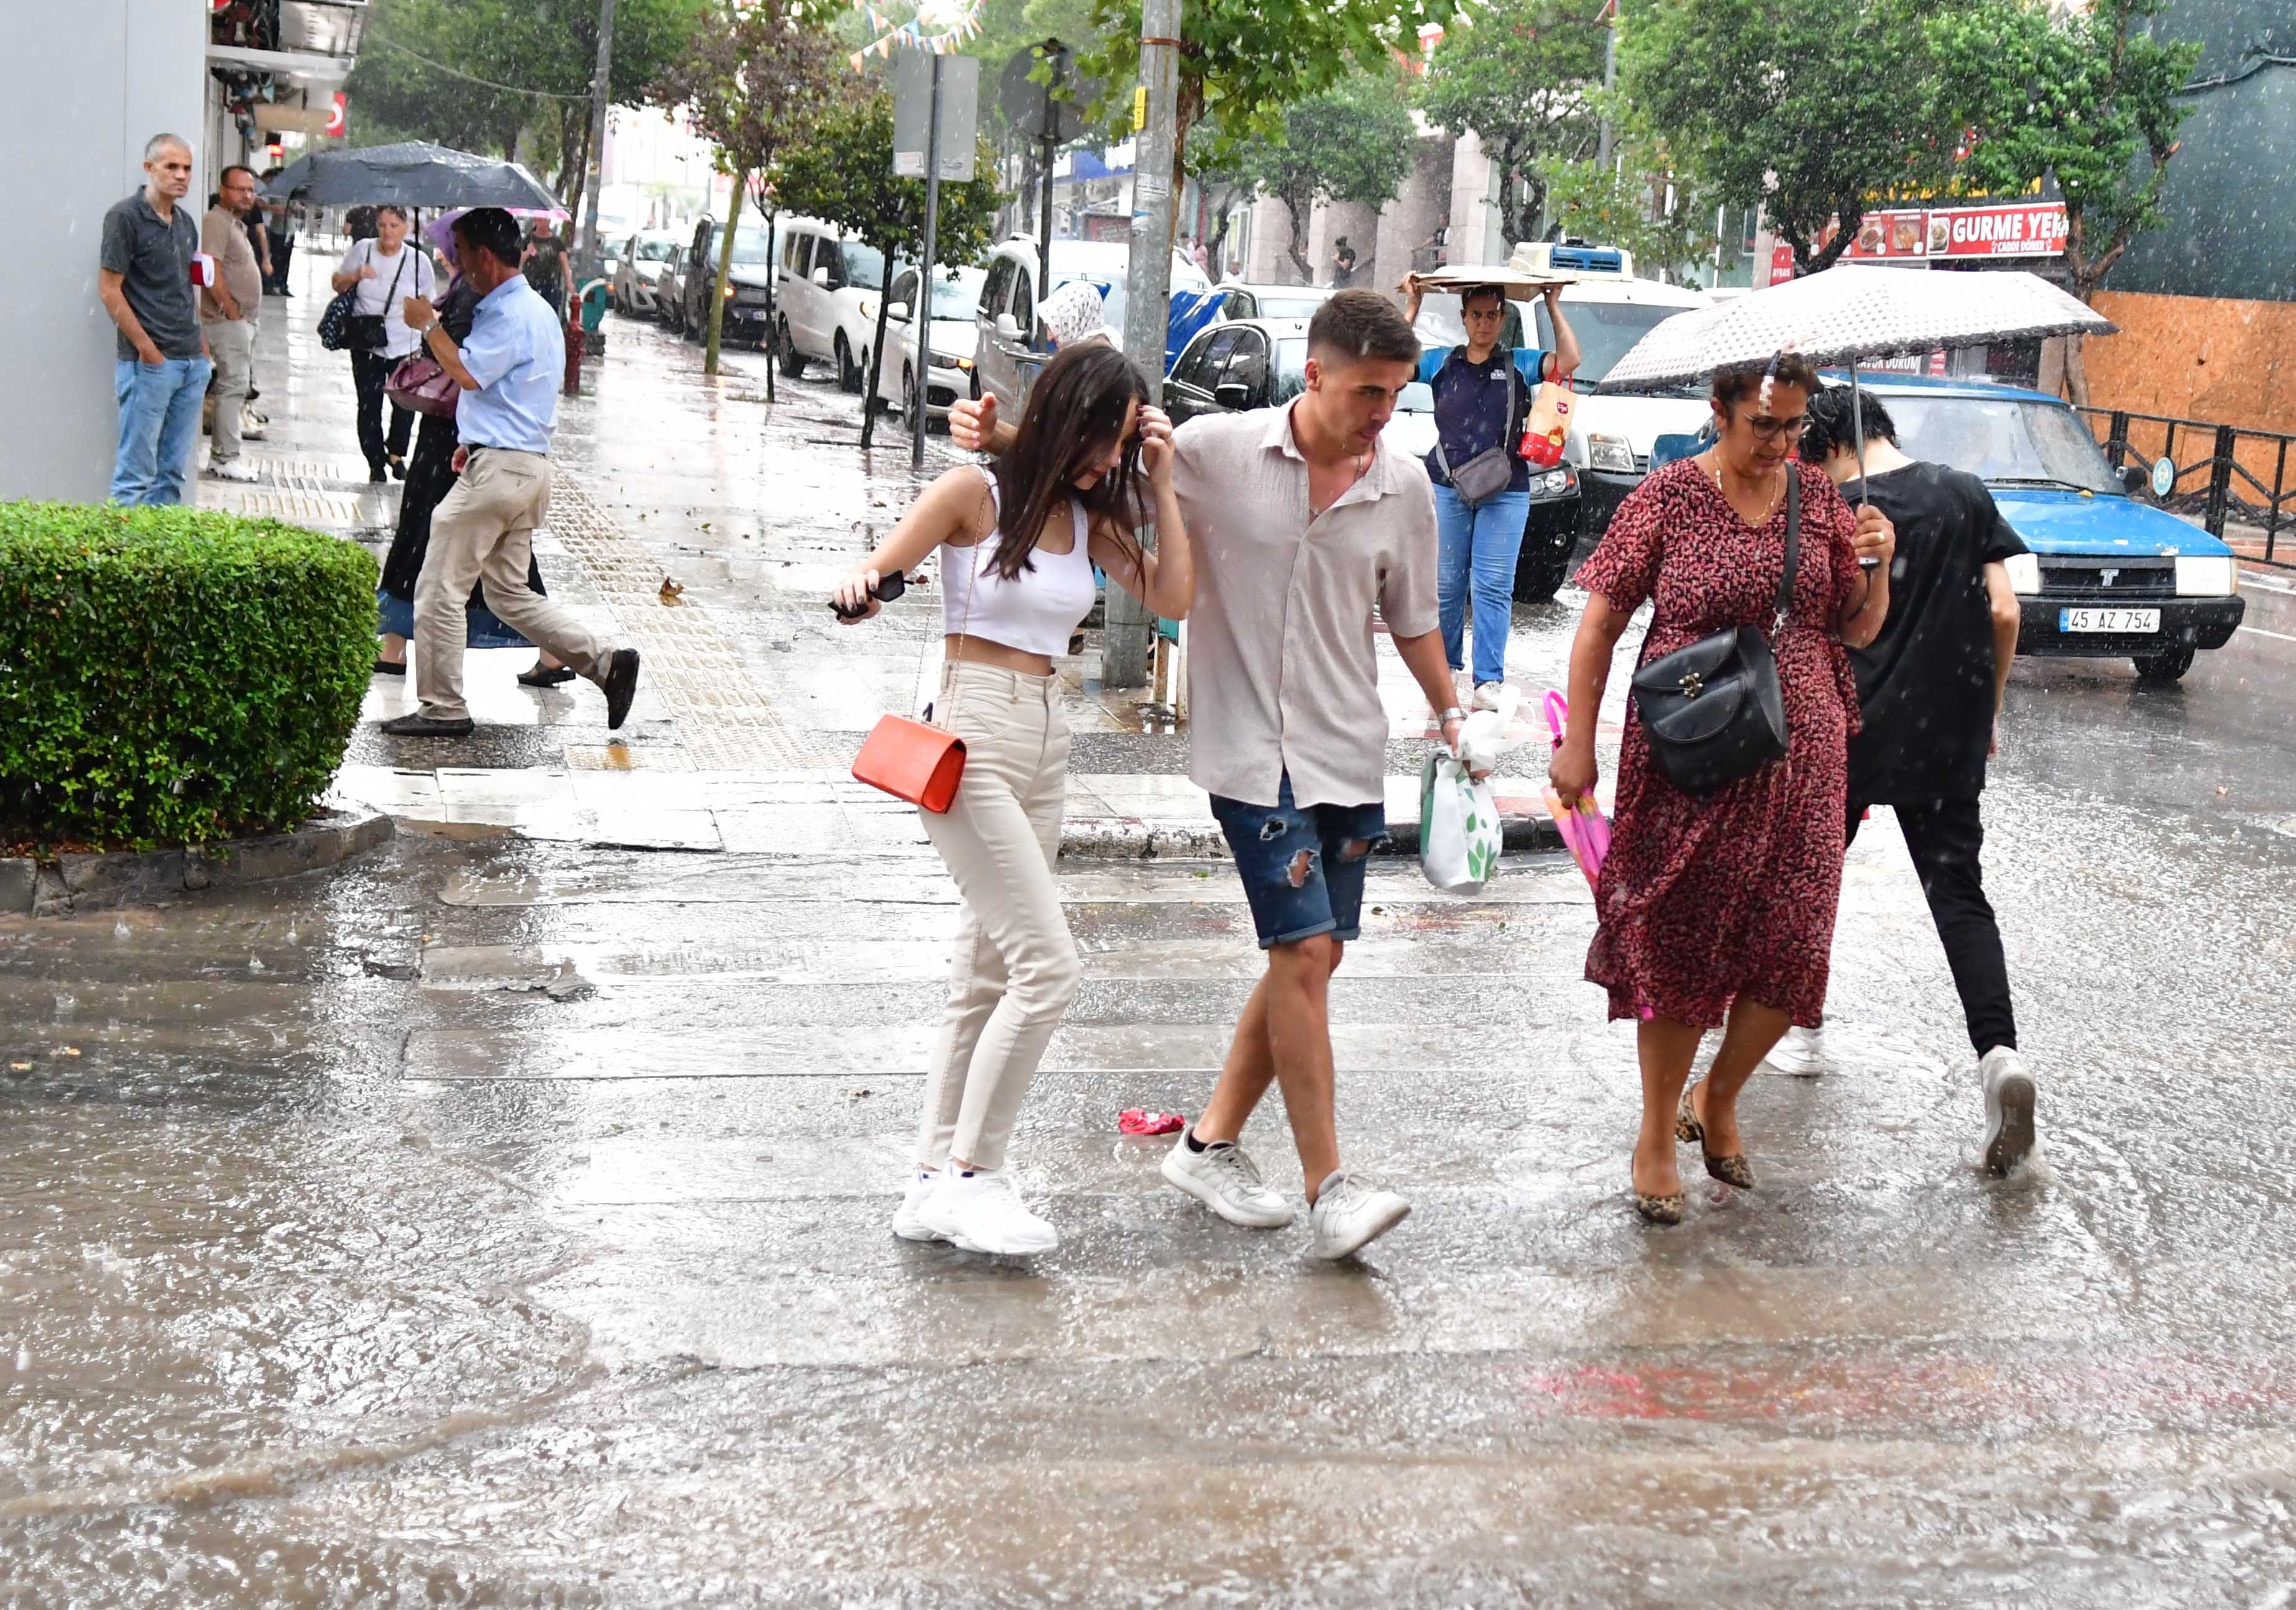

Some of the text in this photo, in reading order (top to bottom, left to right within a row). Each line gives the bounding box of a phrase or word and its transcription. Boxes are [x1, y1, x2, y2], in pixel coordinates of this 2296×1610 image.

[1953, 213, 2023, 243] GURME
[2072, 611, 2088, 628] 45
[2098, 612, 2116, 629] AZ
[2125, 612, 2151, 629] 754
